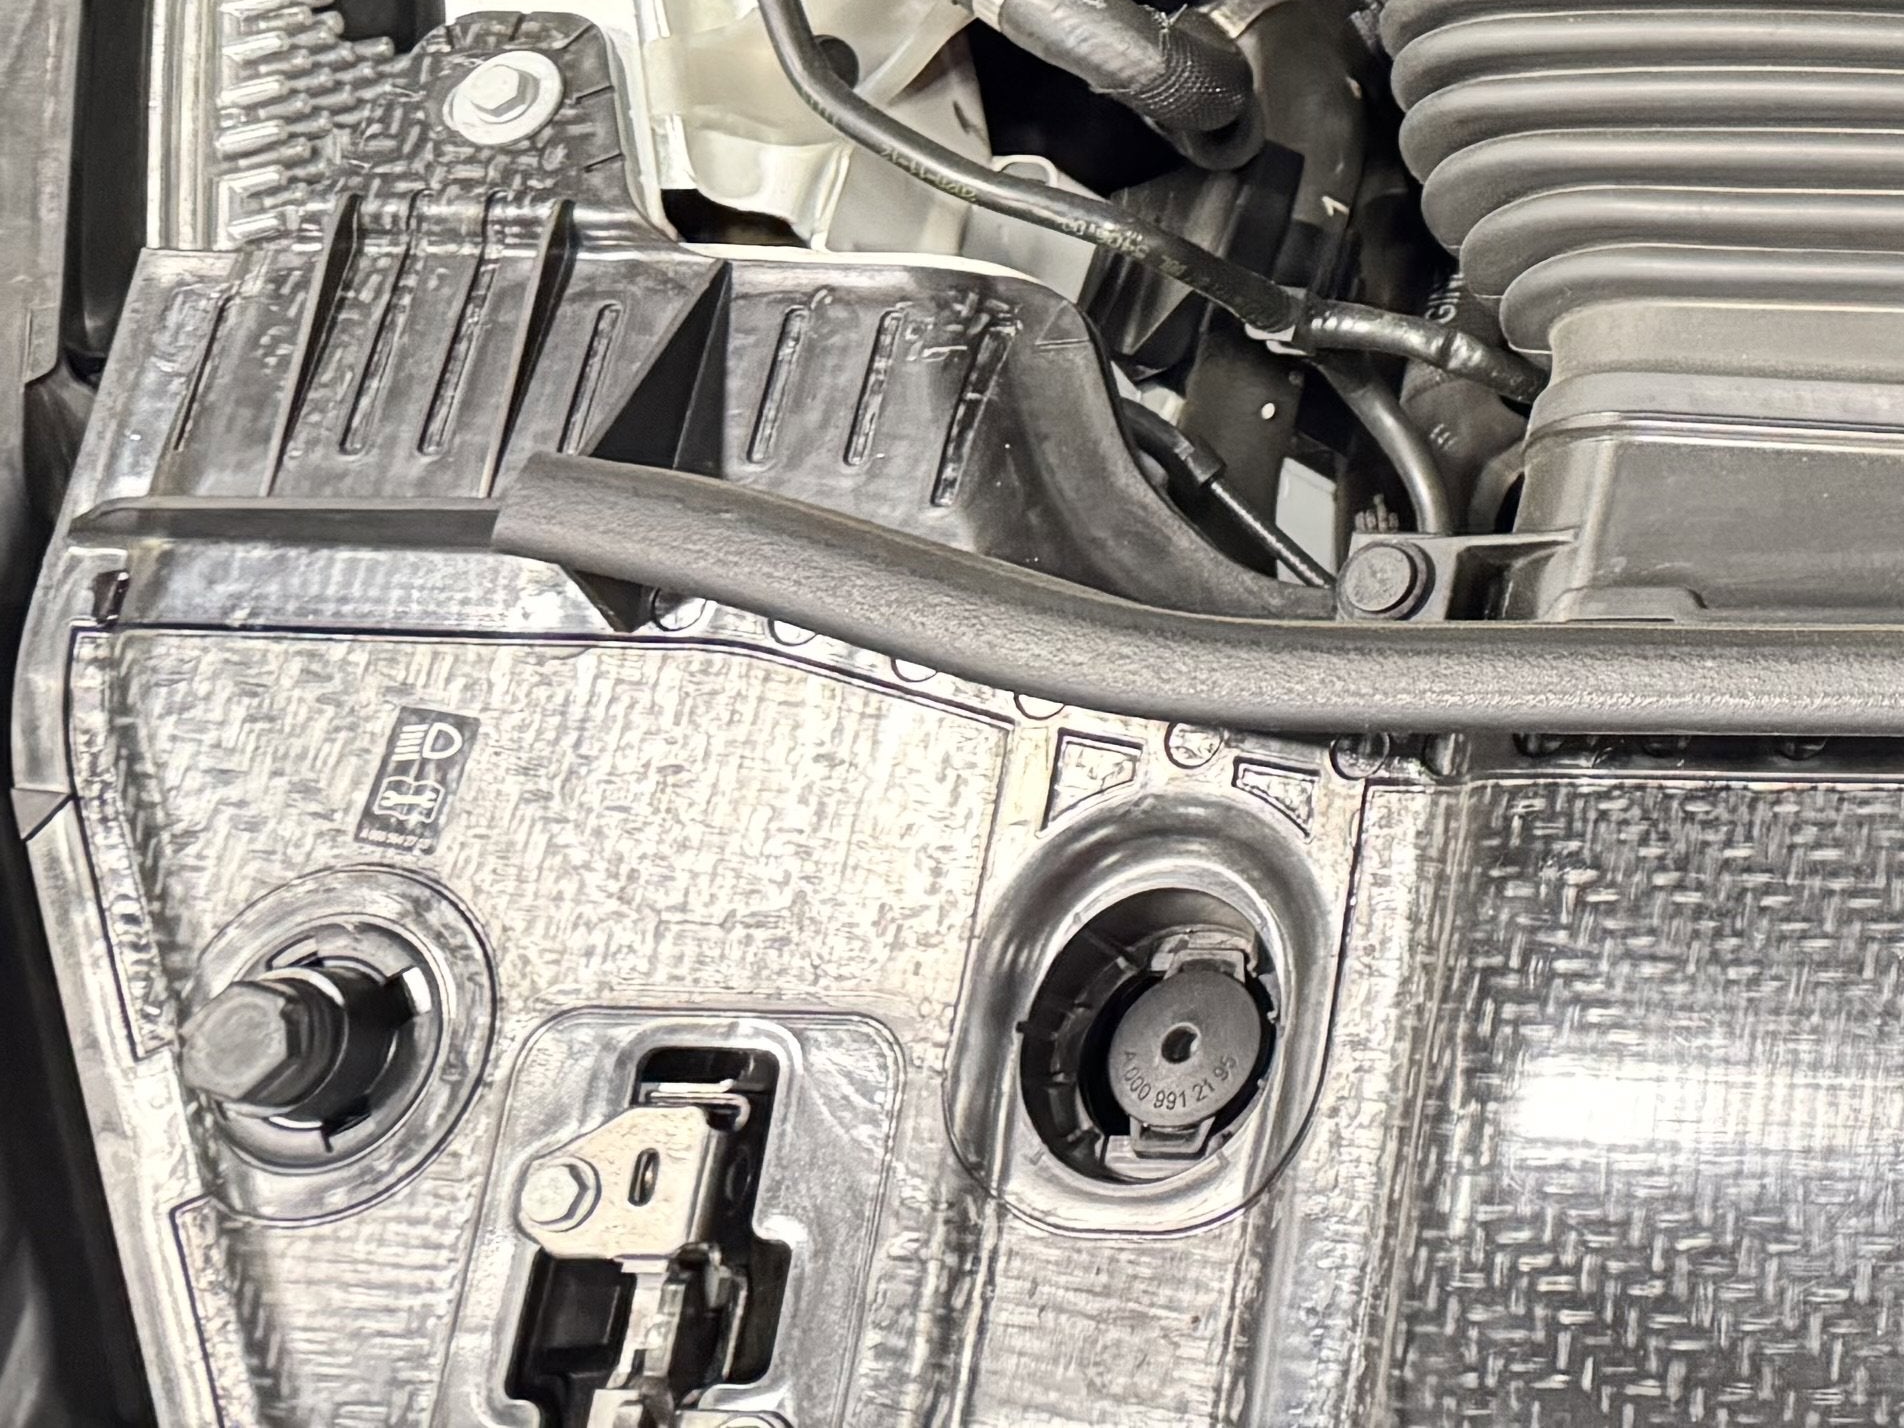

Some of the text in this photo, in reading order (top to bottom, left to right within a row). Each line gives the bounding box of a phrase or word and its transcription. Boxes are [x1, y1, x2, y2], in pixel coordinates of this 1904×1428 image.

[1124, 1051, 1238, 1110] A 000 991 21 95
